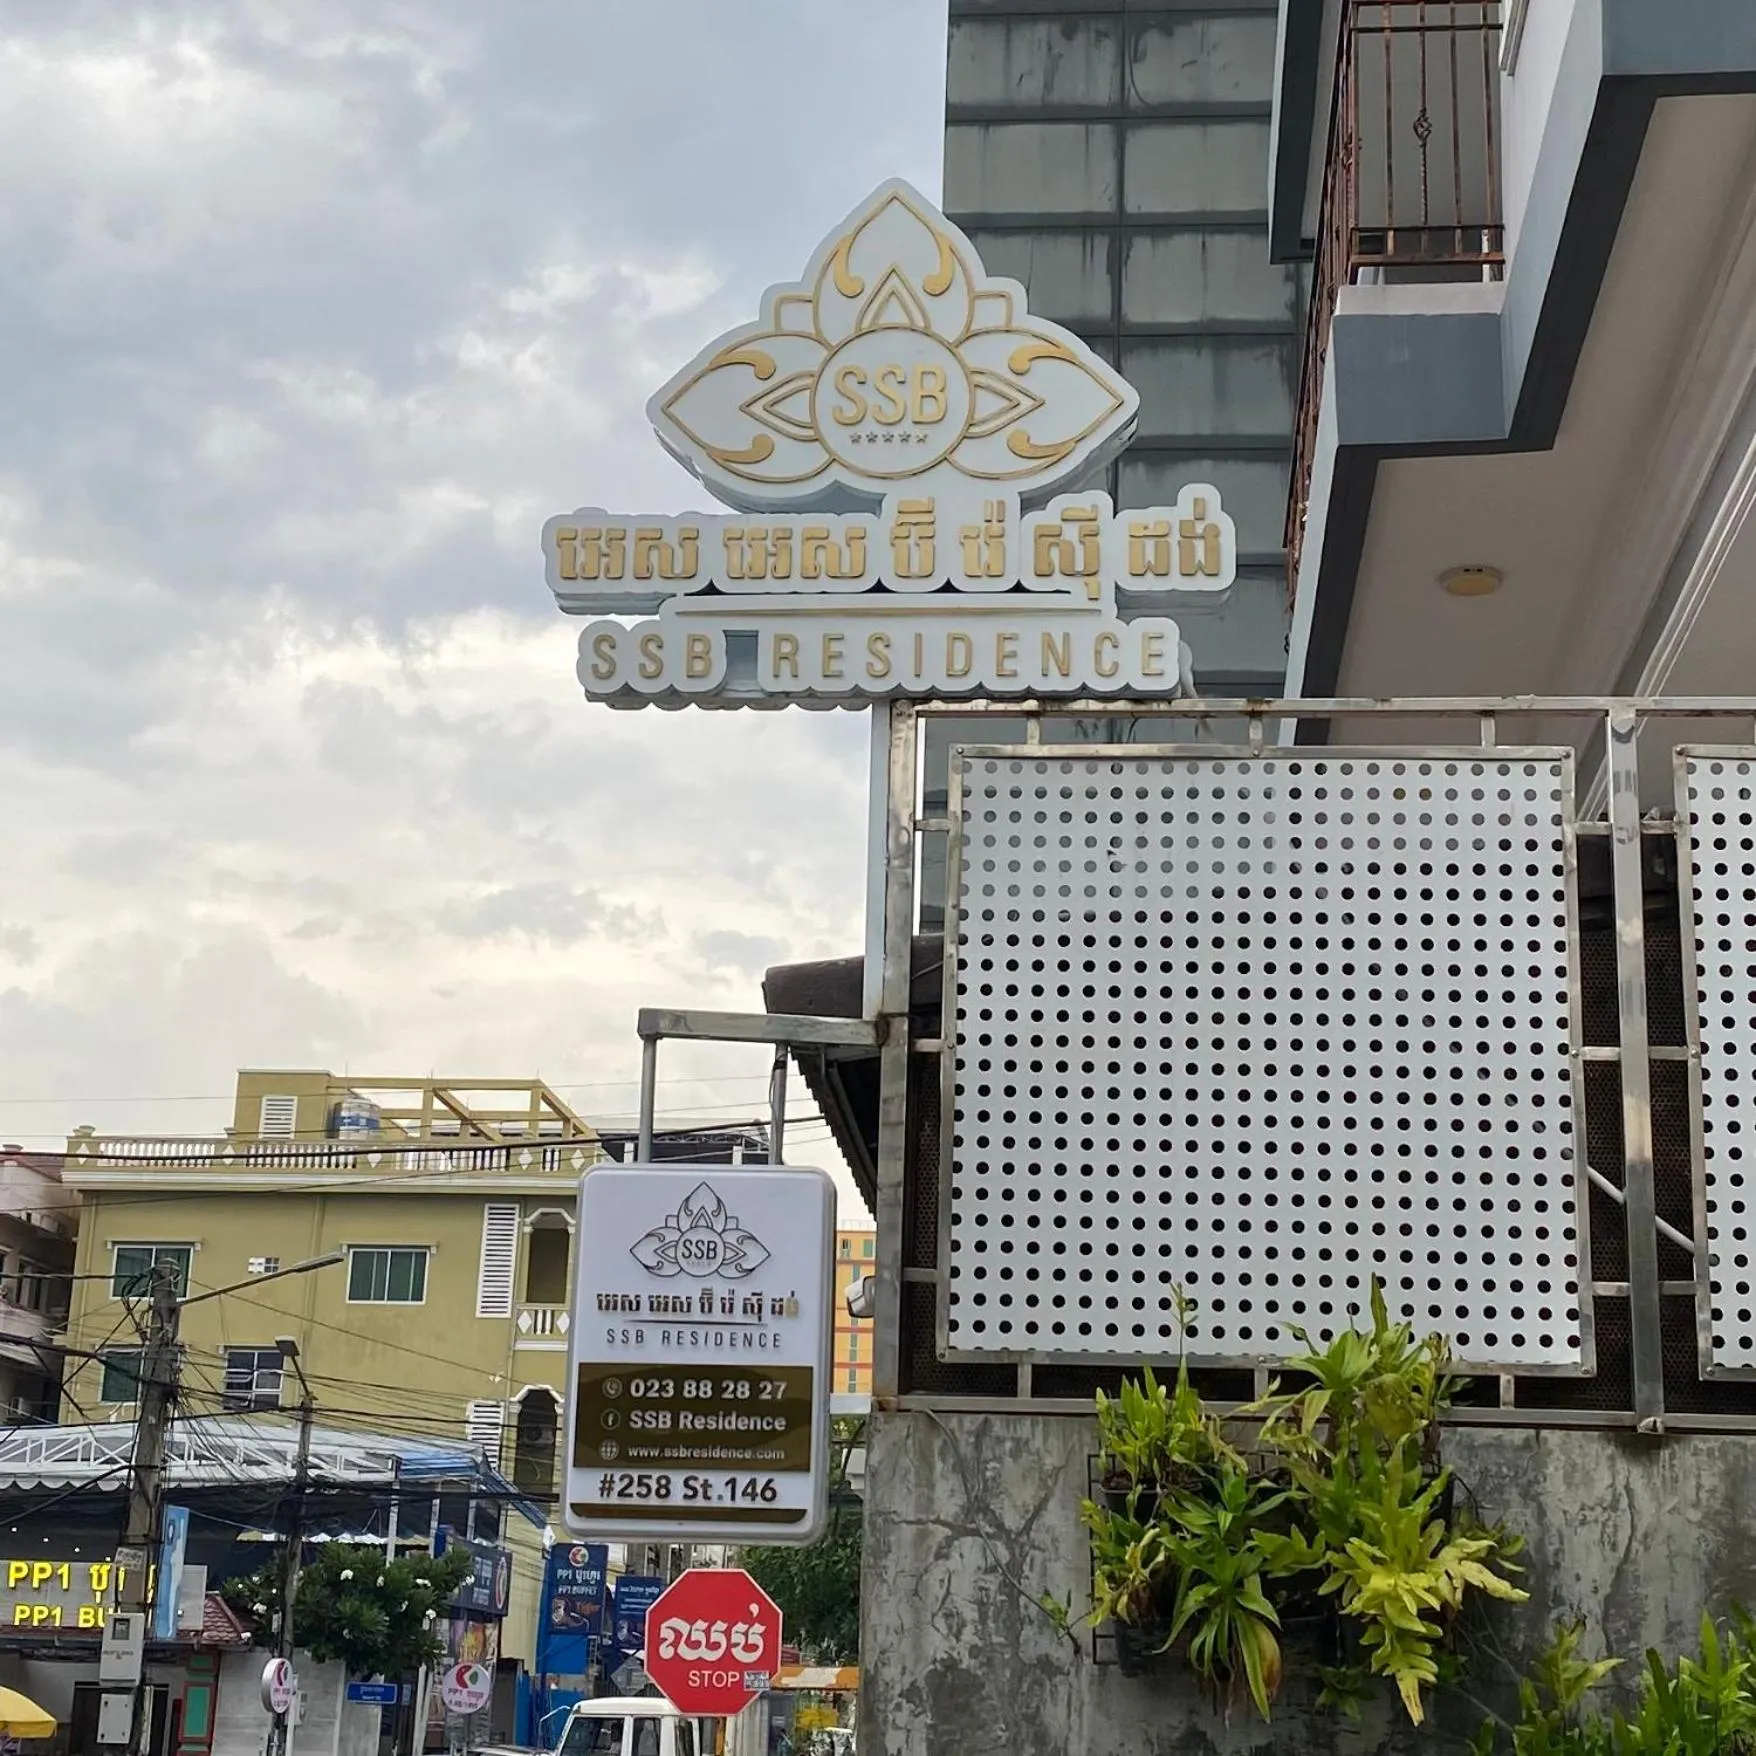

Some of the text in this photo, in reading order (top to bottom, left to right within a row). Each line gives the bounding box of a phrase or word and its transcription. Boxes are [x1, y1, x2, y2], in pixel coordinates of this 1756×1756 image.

[832, 363, 948, 426] SSB
[590, 630, 1165, 679] SSB RESIDENCE
[681, 1238, 718, 1260] SSB
[606, 1328, 782, 1348] SSB RESIDENCE
[630, 1379, 787, 1400] 023 88 28 27
[629, 1409, 787, 1431] SSB Residence
[628, 1444, 786, 1461] www.ssbresidence.com
[599, 1473, 778, 1502] #258 St.146
[8, 1561, 70, 1591] PP1
[13, 1604, 63, 1628] PP1
[658, 1603, 768, 1663] ឈប់
[688, 1670, 740, 1688] STOP
